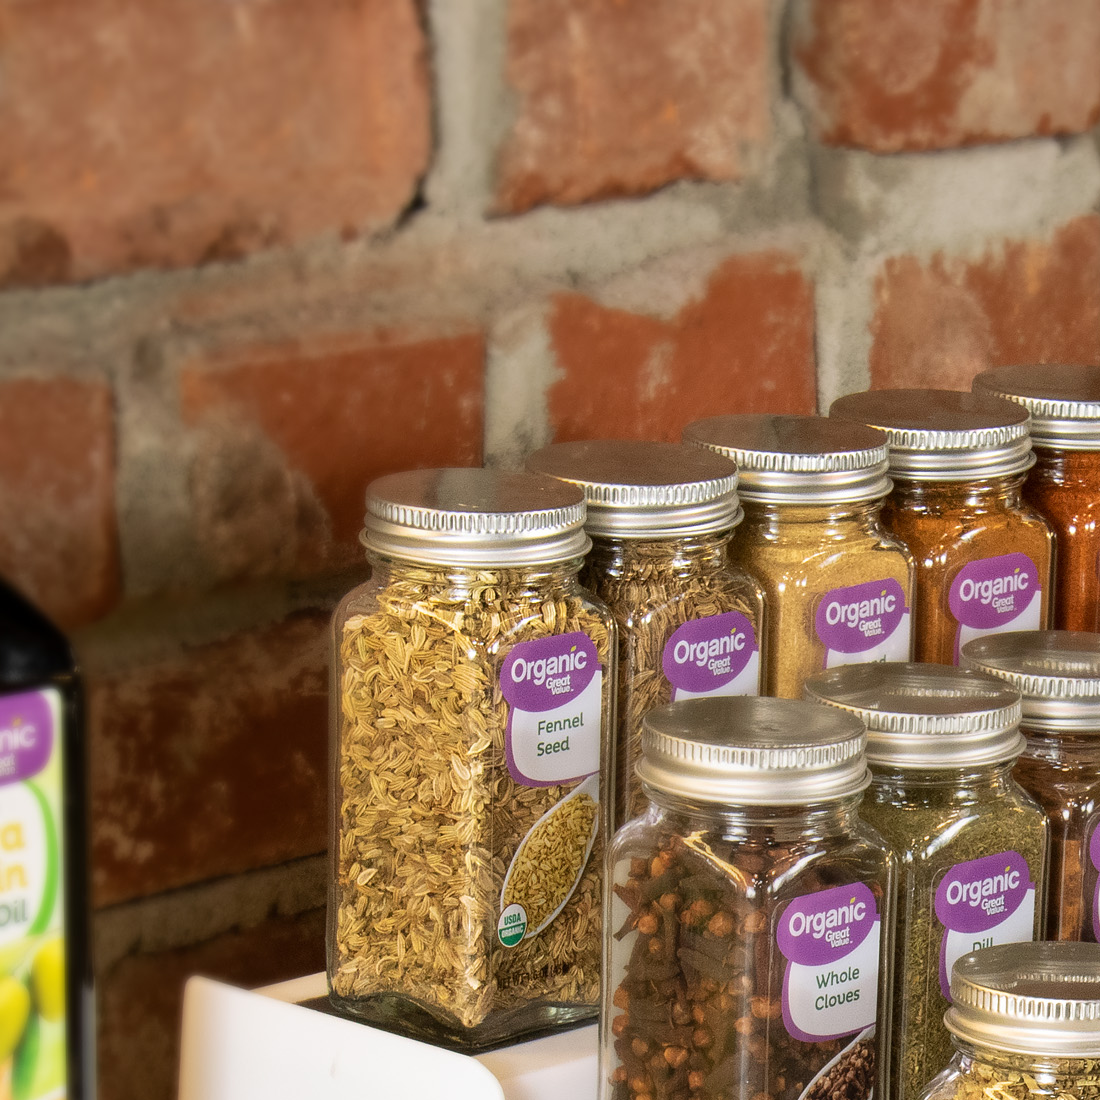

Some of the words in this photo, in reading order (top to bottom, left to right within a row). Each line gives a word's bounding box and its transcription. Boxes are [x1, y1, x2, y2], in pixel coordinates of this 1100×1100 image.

[959, 568, 1029, 604] Organic
[826, 590, 895, 628] Organic
[992, 595, 1014, 608] Great
[997, 604, 1013, 614] Value
[859, 618, 881, 632] Great
[865, 628, 881, 637] Value
[674, 628, 745, 666] Organic
[511, 646, 587, 686] Organic
[708, 655, 730, 670] Great
[713, 666, 731, 675] Value
[546, 675, 570, 689] Great
[552, 685, 570, 695] Value
[538, 712, 584, 735] Fennel
[537, 737, 570, 757] Seed
[947, 866, 1020, 906] Organic
[981, 895, 1004, 910] Great
[789, 897, 866, 939] Organic
[987, 906, 1004, 915] Value
[504, 913, 521, 925] USDA
[825, 928, 850, 942] Great
[831, 939, 849, 948] Value
[816, 967, 859, 989] Whole
[815, 989, 860, 1010] Cloves
